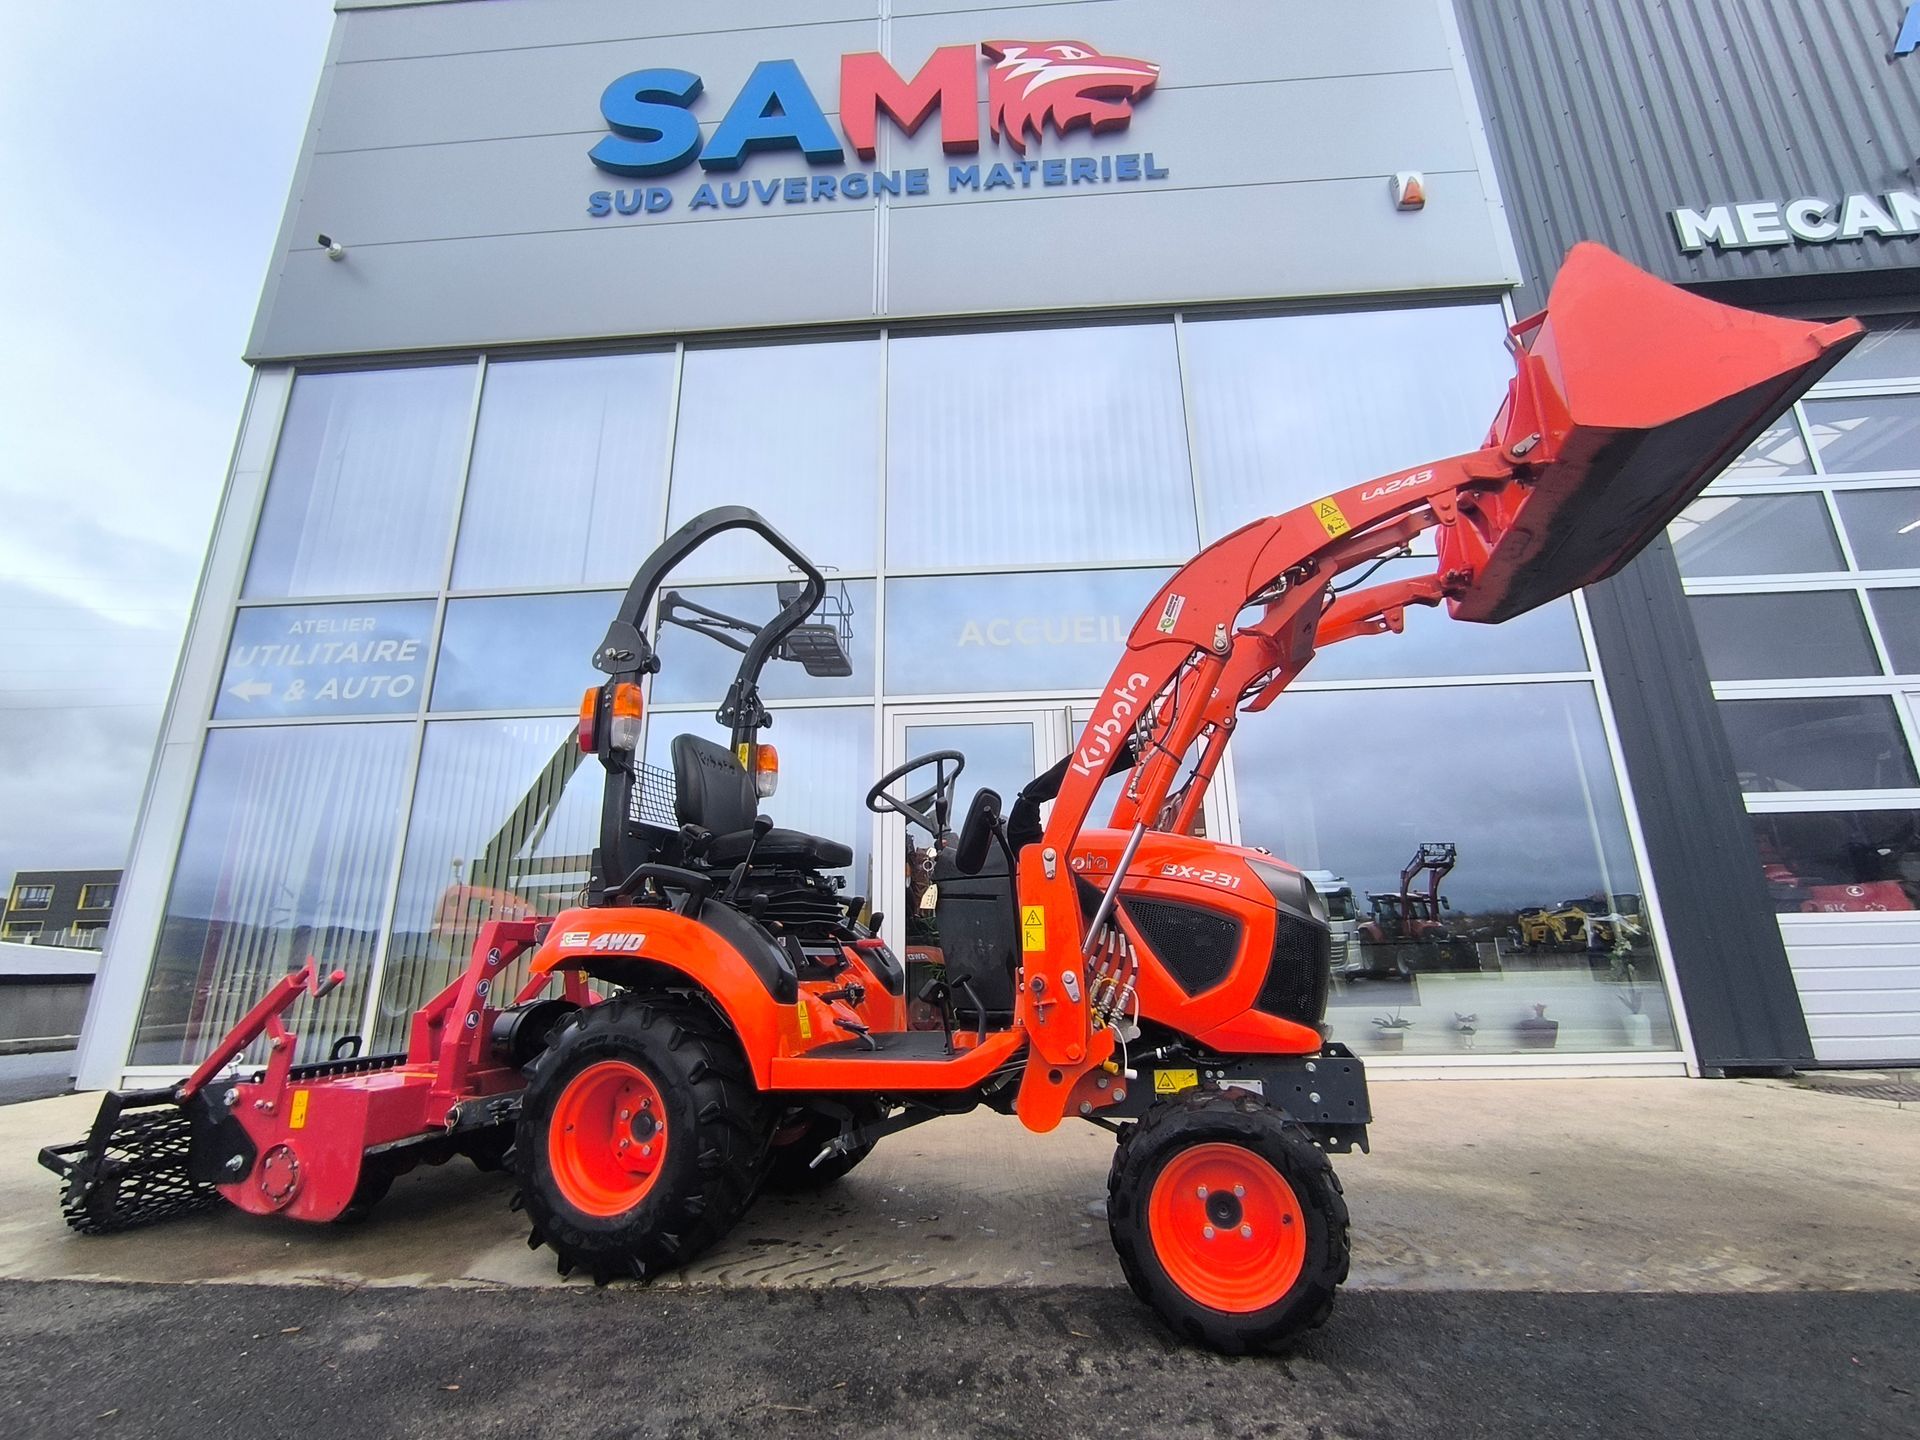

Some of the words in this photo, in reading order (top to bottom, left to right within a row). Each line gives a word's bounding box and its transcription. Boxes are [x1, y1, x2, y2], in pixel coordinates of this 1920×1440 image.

[587, 43, 981, 178] SAM
[586, 187, 673, 217] SUD
[688, 167, 930, 211] AUVERGNE
[948, 152, 1170, 191] MATERIEL
[1360, 469, 1434, 503] LA243
[287, 617, 378, 636] ATELIER
[957, 615, 1130, 648] ACCUEIL
[232, 639, 422, 668] UTILITAIRE
[281, 677, 306, 702] &
[313, 674, 416, 701] AUTO
[1071, 672, 1150, 777] Kubota
[1161, 863, 1241, 889] BX-231
[588, 932, 647, 951] 4WD
